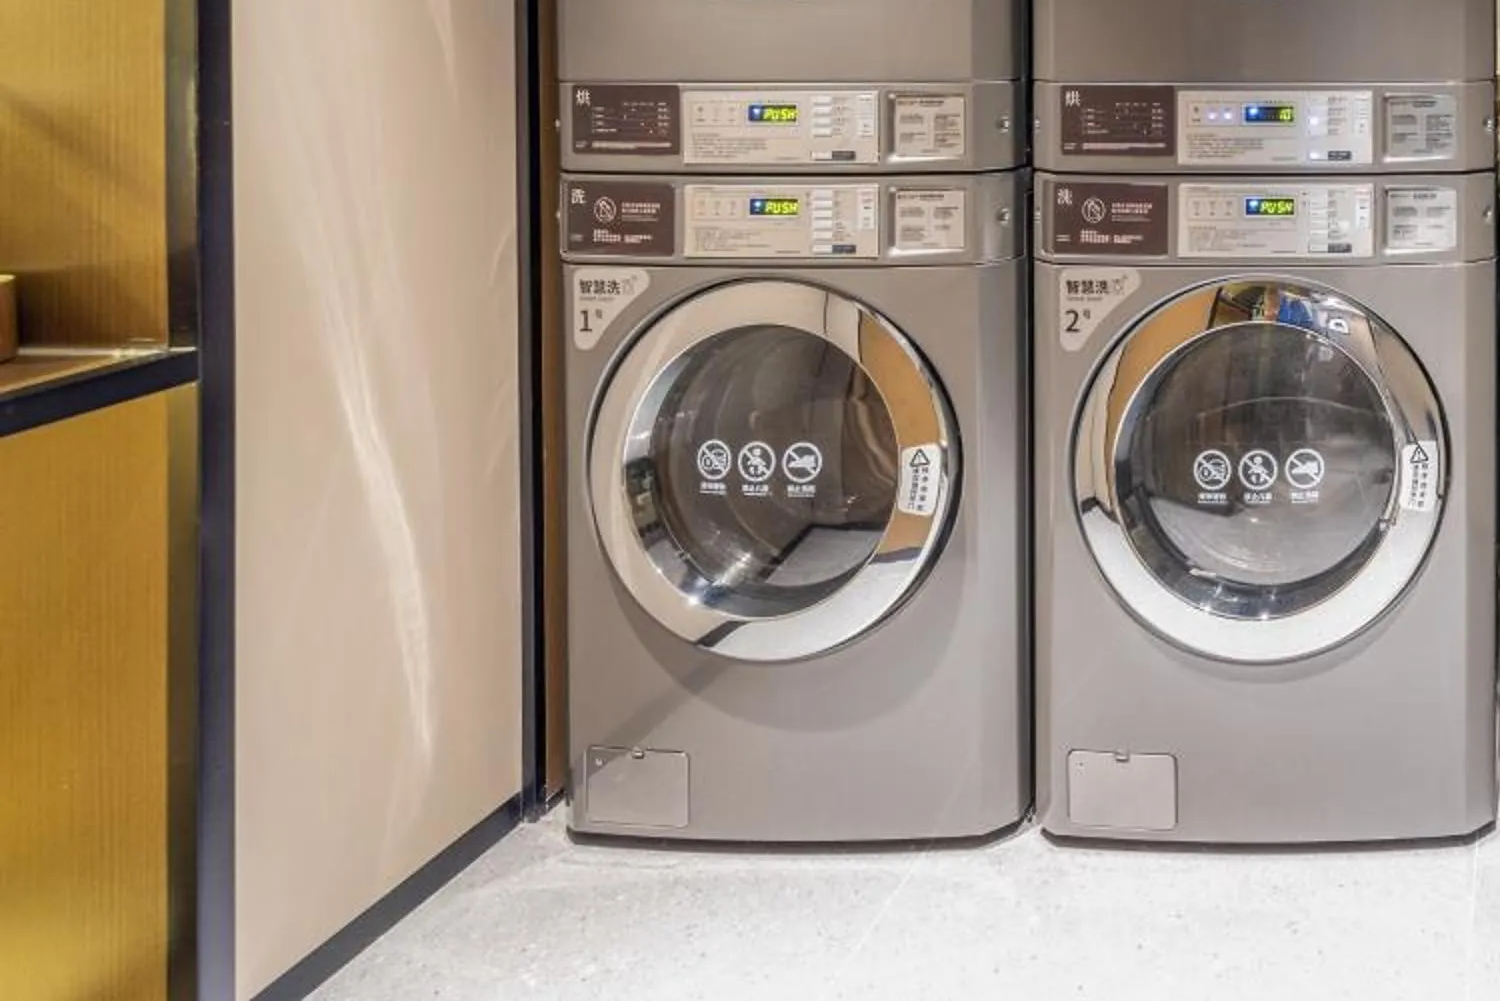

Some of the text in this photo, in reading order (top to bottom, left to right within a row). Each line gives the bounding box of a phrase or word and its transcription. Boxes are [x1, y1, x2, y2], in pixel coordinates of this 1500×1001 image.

[763, 107, 797, 120] PUSH
[765, 200, 799, 214] PUSH
[1259, 201, 1293, 213] PUSH
